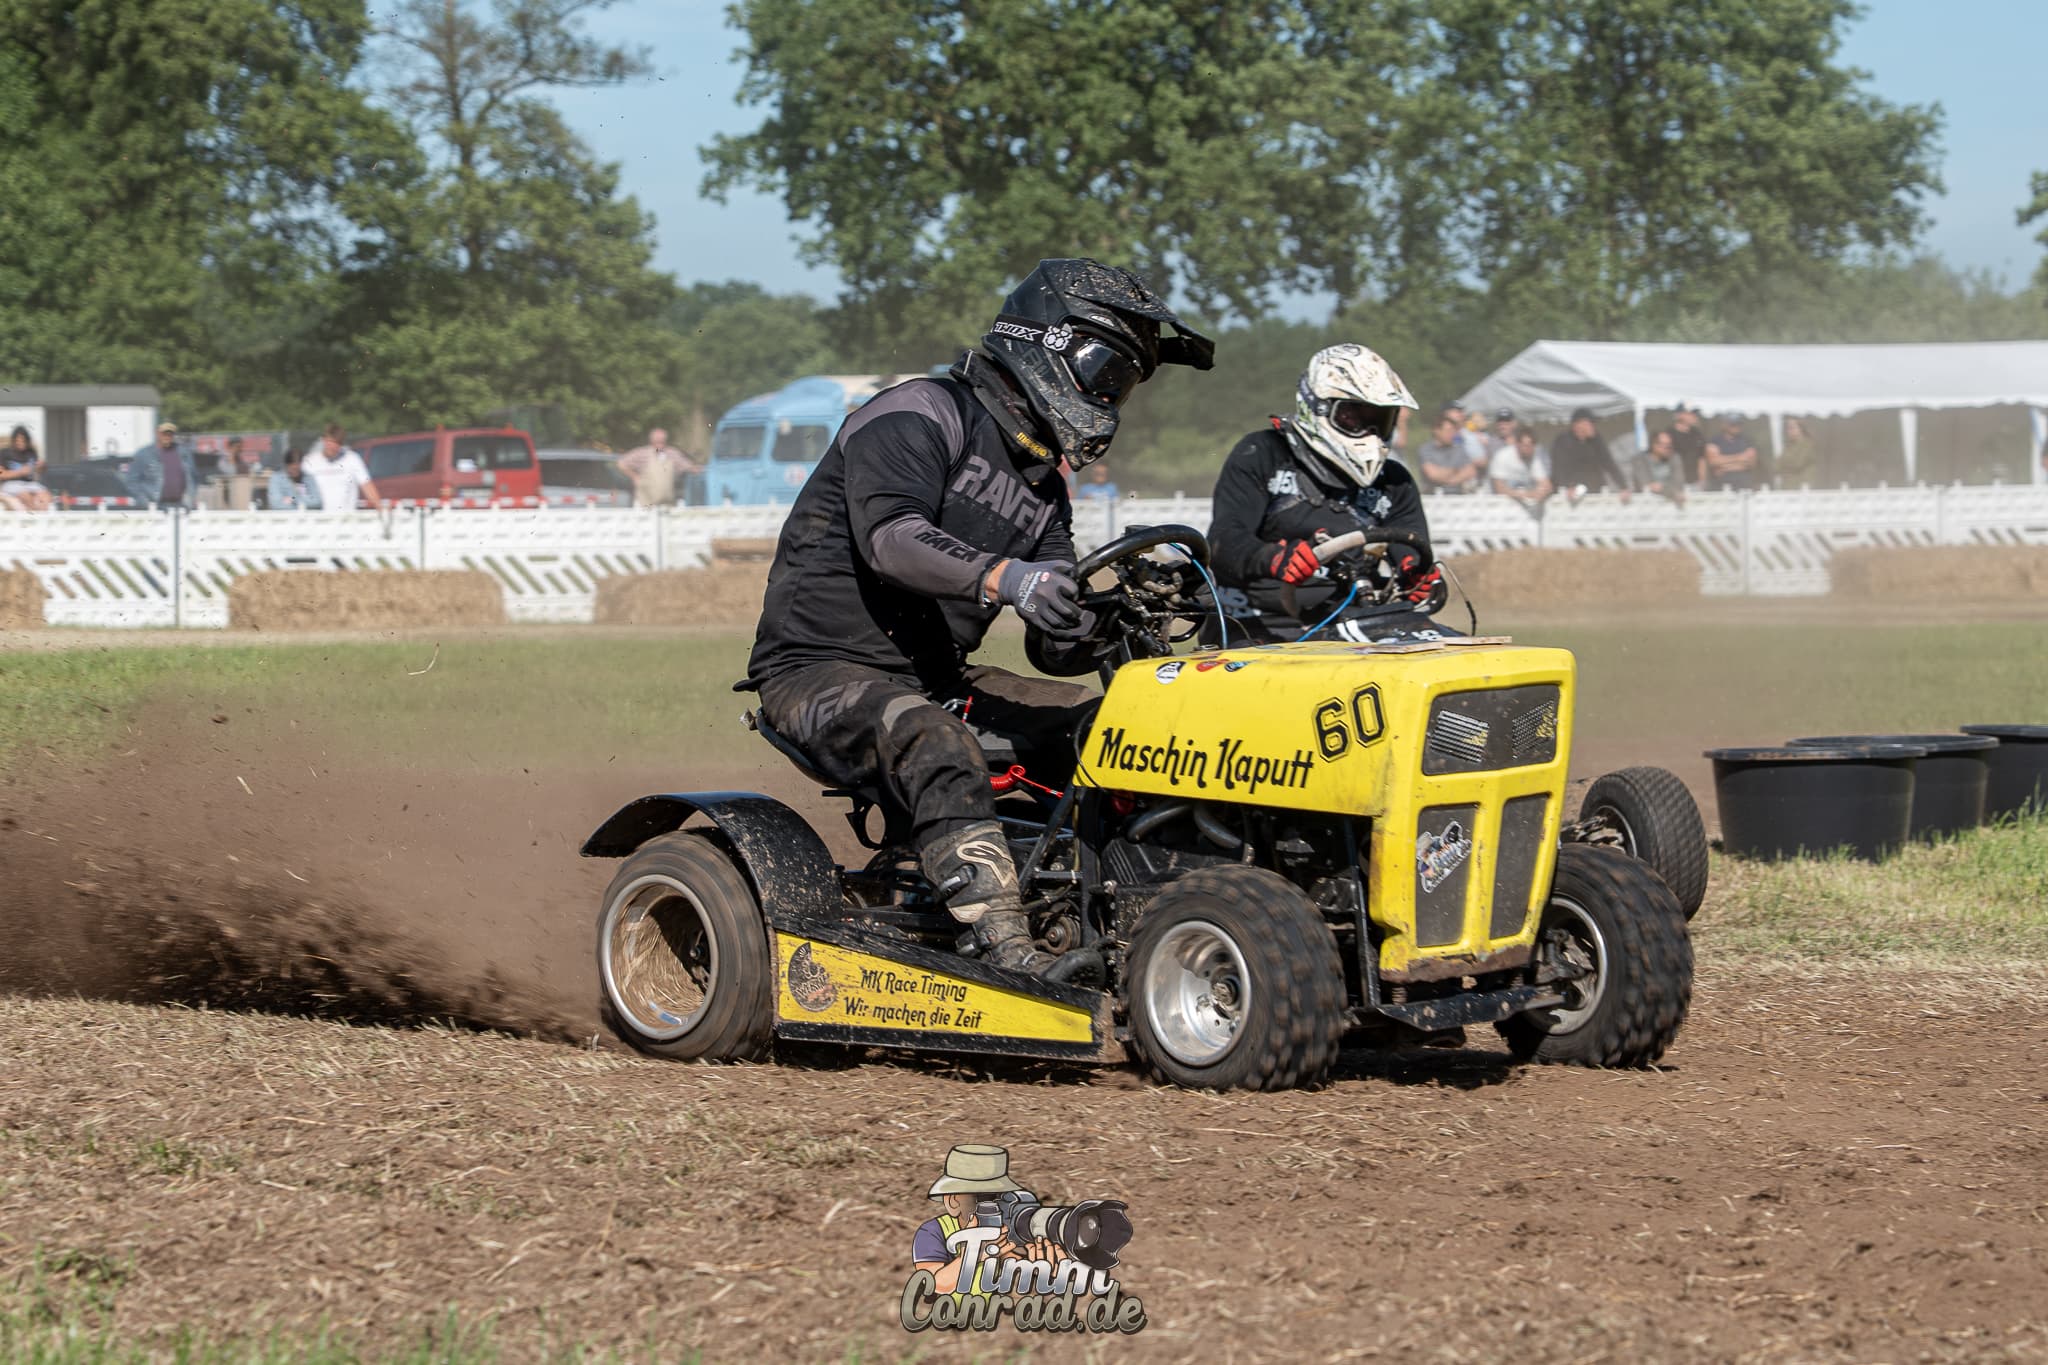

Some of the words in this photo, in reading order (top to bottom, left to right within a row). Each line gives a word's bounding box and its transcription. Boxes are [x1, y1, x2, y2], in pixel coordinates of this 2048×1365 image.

[952, 455, 1058, 541] RAVEN
[914, 529, 980, 563] RAVEN
[1311, 681, 1388, 763] 60
[1096, 727, 1207, 789] Maschin
[1215, 738, 1314, 794] Kaputt
[844, 996, 869, 1017] Wir
[872, 1003, 927, 1027] machen
[930, 1006, 951, 1026] die
[954, 1008, 982, 1028] Zeit
[885, 972, 917, 994] Race
[921, 974, 967, 1002] Timing
